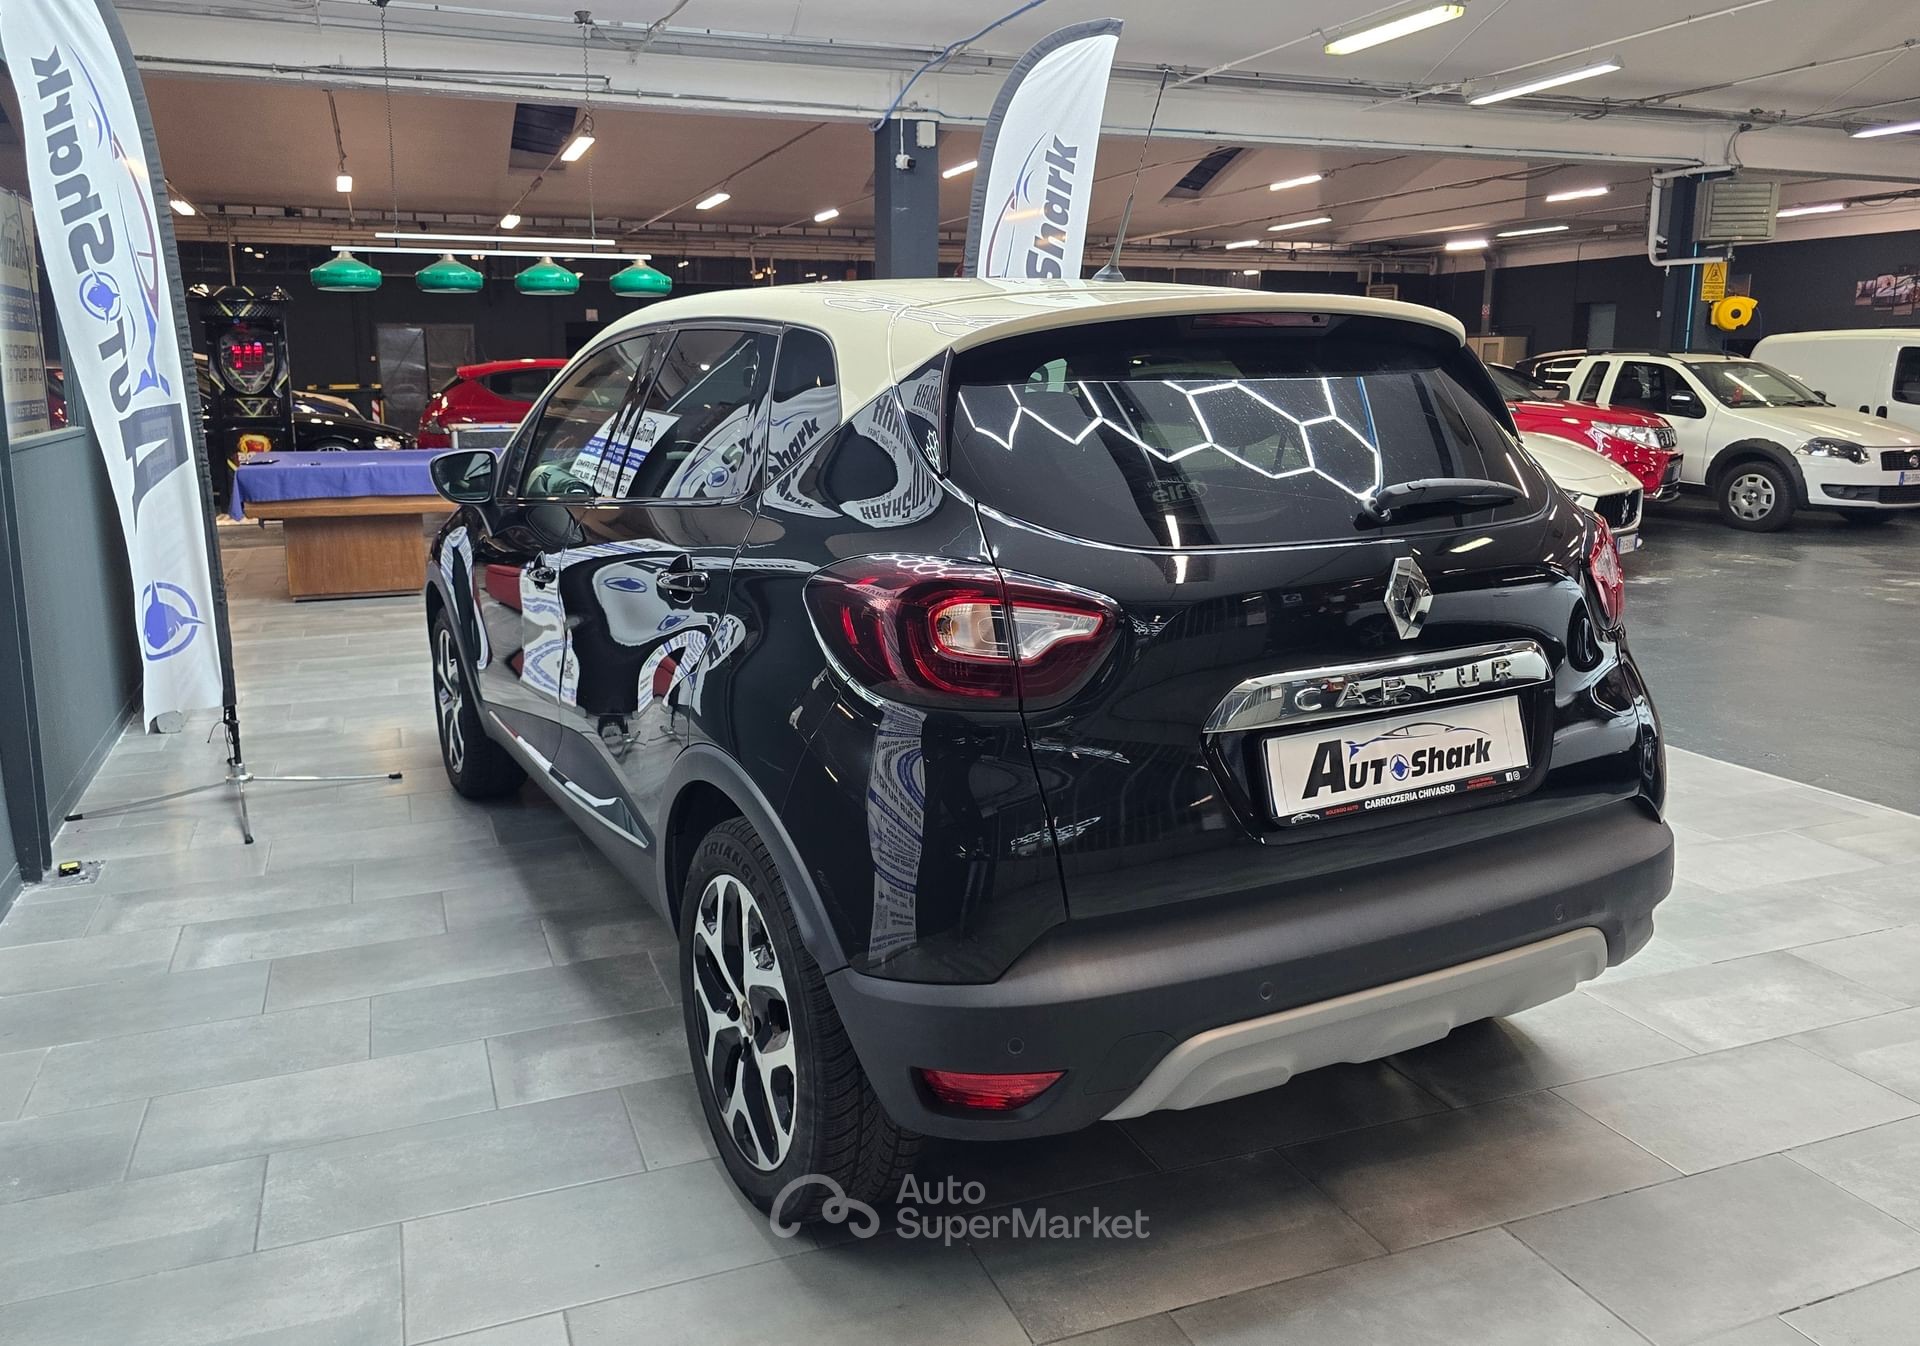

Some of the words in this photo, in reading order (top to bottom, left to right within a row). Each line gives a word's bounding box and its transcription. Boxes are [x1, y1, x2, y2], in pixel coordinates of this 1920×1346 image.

[1294, 658, 1513, 713] CAPTUR
[1364, 791, 1418, 810] CARROZZERIA
[1418, 783, 1456, 799] CHIVASSO
